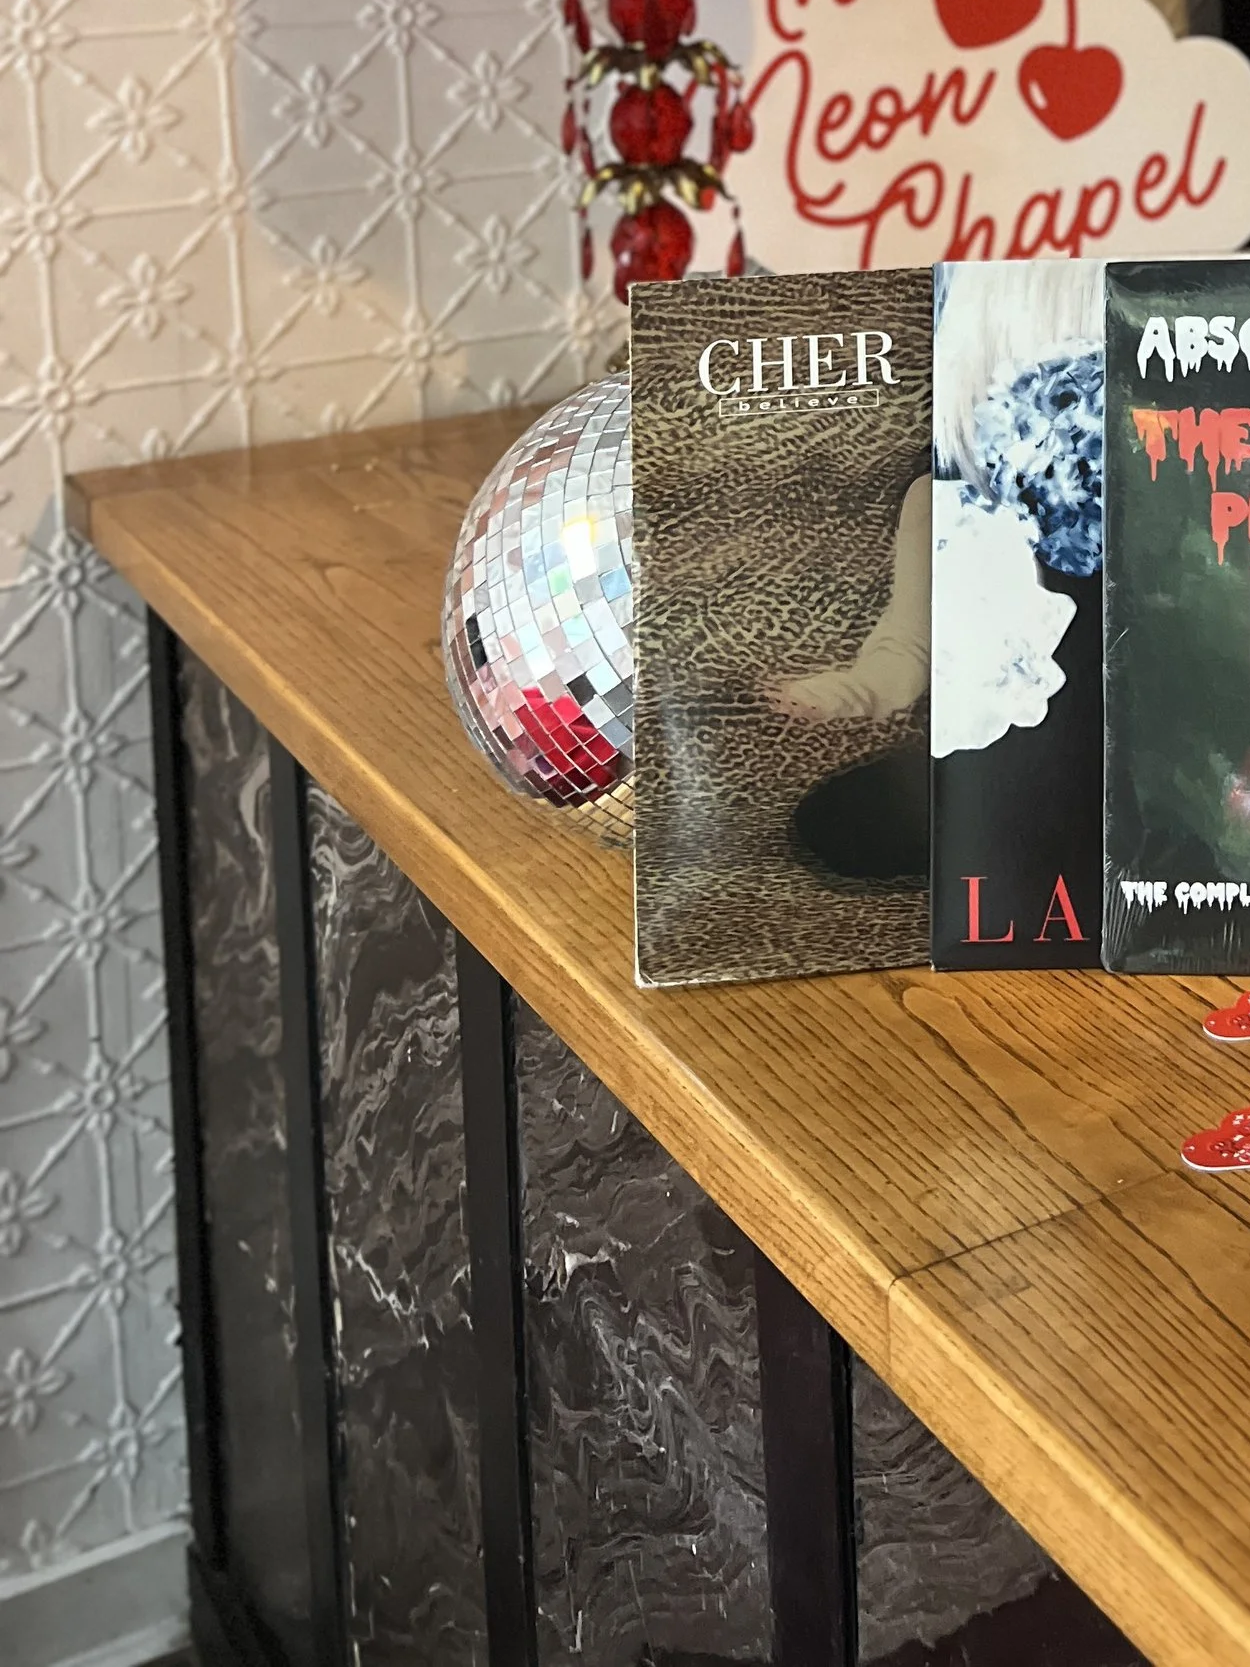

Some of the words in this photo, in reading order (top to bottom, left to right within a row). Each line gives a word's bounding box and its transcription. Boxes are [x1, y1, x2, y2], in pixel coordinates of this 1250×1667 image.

[698, 330, 901, 395] CHER
[738, 394, 859, 412] believe
[1121, 880, 1168, 914] THE
